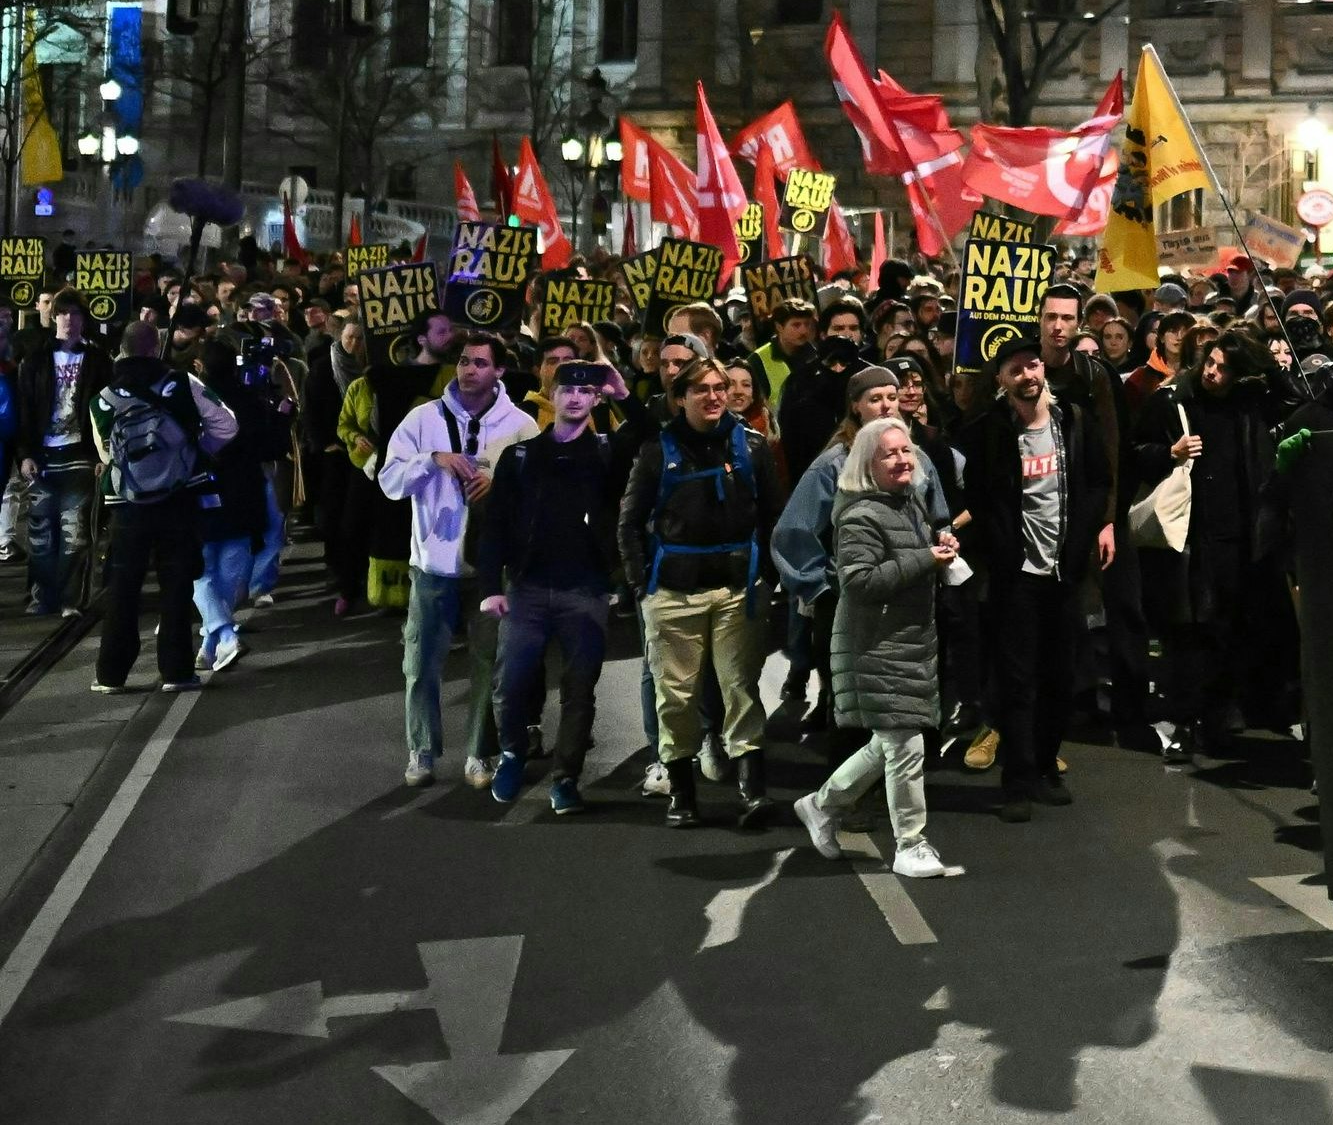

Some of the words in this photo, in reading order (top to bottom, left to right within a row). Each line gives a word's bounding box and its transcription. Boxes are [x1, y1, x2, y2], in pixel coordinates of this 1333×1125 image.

[789, 170, 837, 191] NAZIS
[786, 185, 832, 209] RAUS
[741, 203, 762, 220] ZIS
[457, 224, 533, 255] NAZIS
[972, 213, 1033, 244] NAZIS
[1, 238, 44, 257] NAZIS
[661, 242, 723, 272] NAZIS
[1, 255, 44, 275] RAUS
[76, 253, 130, 271] NAZIS
[453, 249, 528, 283] RAUS
[745, 257, 811, 290] NAZIS
[966, 243, 1053, 281] NAZIS
[76, 270, 130, 290] RAUS
[360, 266, 434, 300] NAZIS
[547, 280, 614, 306] NAZIS
[656, 265, 717, 300] RAUS
